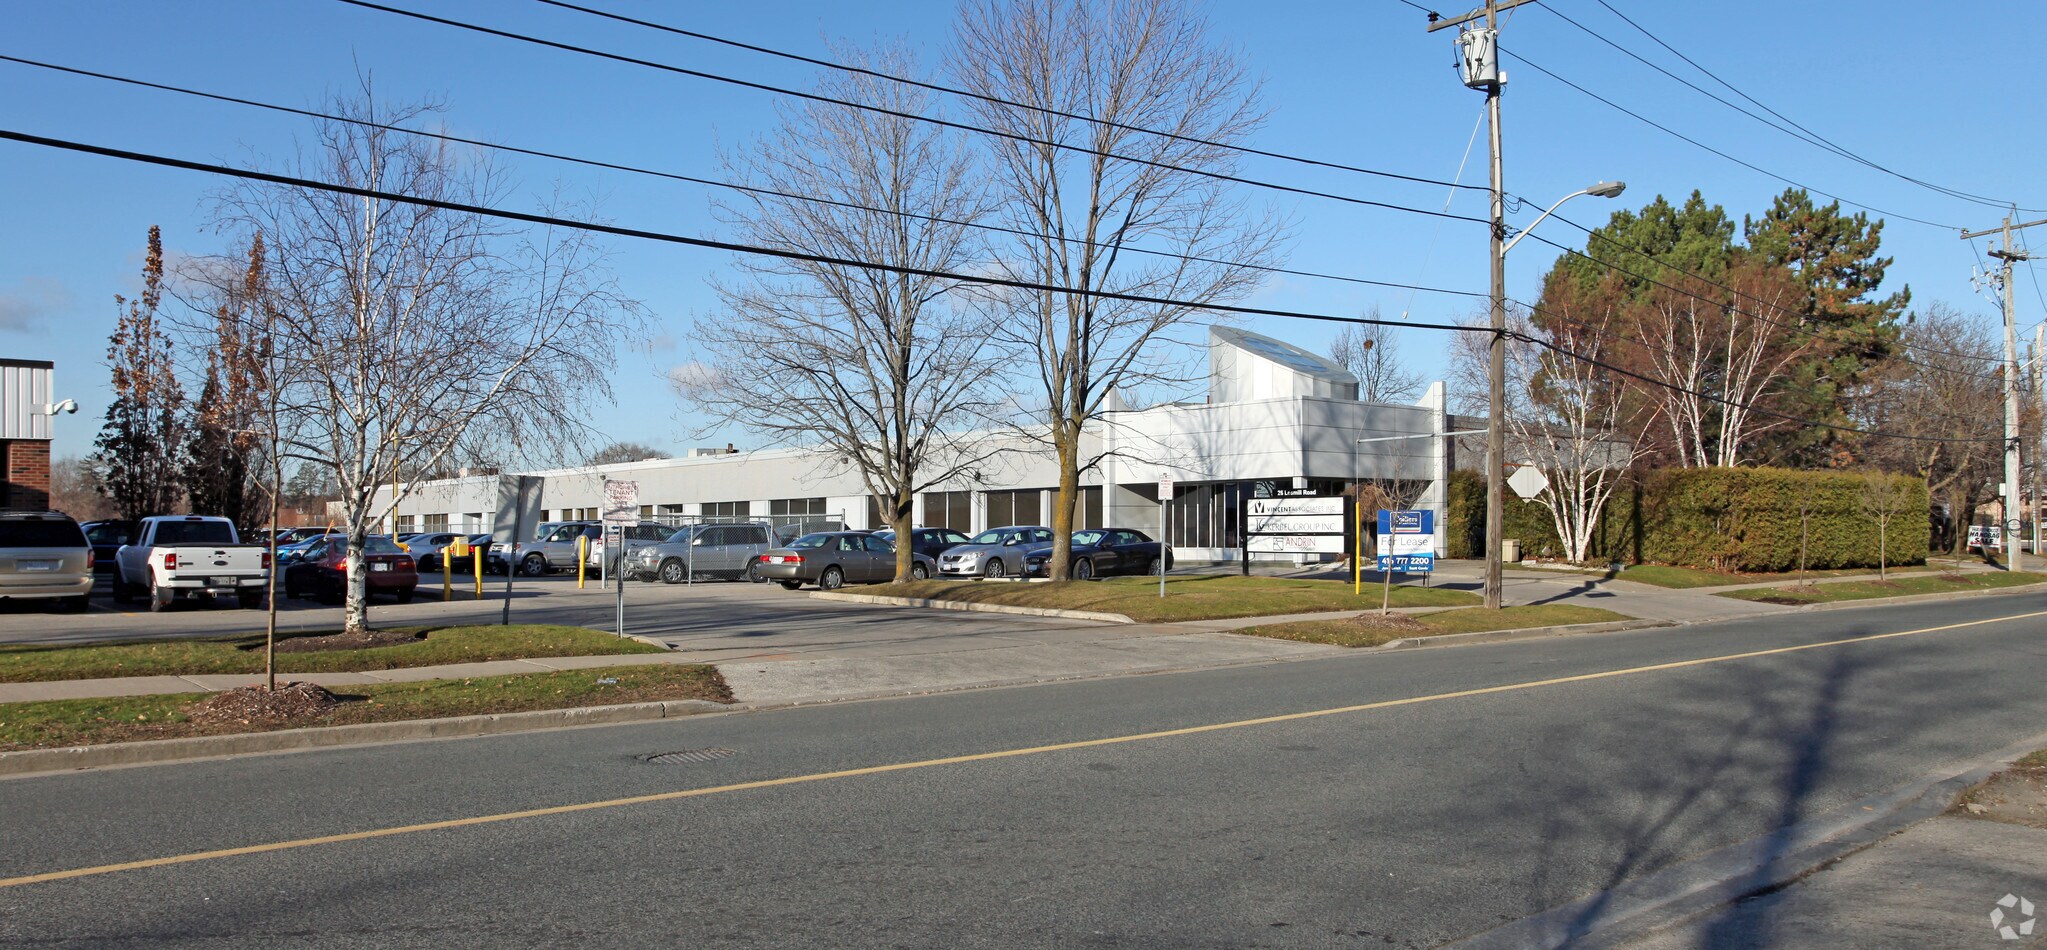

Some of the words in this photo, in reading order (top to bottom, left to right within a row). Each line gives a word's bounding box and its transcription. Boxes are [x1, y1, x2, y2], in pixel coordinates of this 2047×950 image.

[1293, 523, 1320, 531] GROUP
[1969, 531, 2000, 539] HANDBAG
[1401, 537, 1428, 546] Lease
[1974, 537, 1994, 545] SALE
